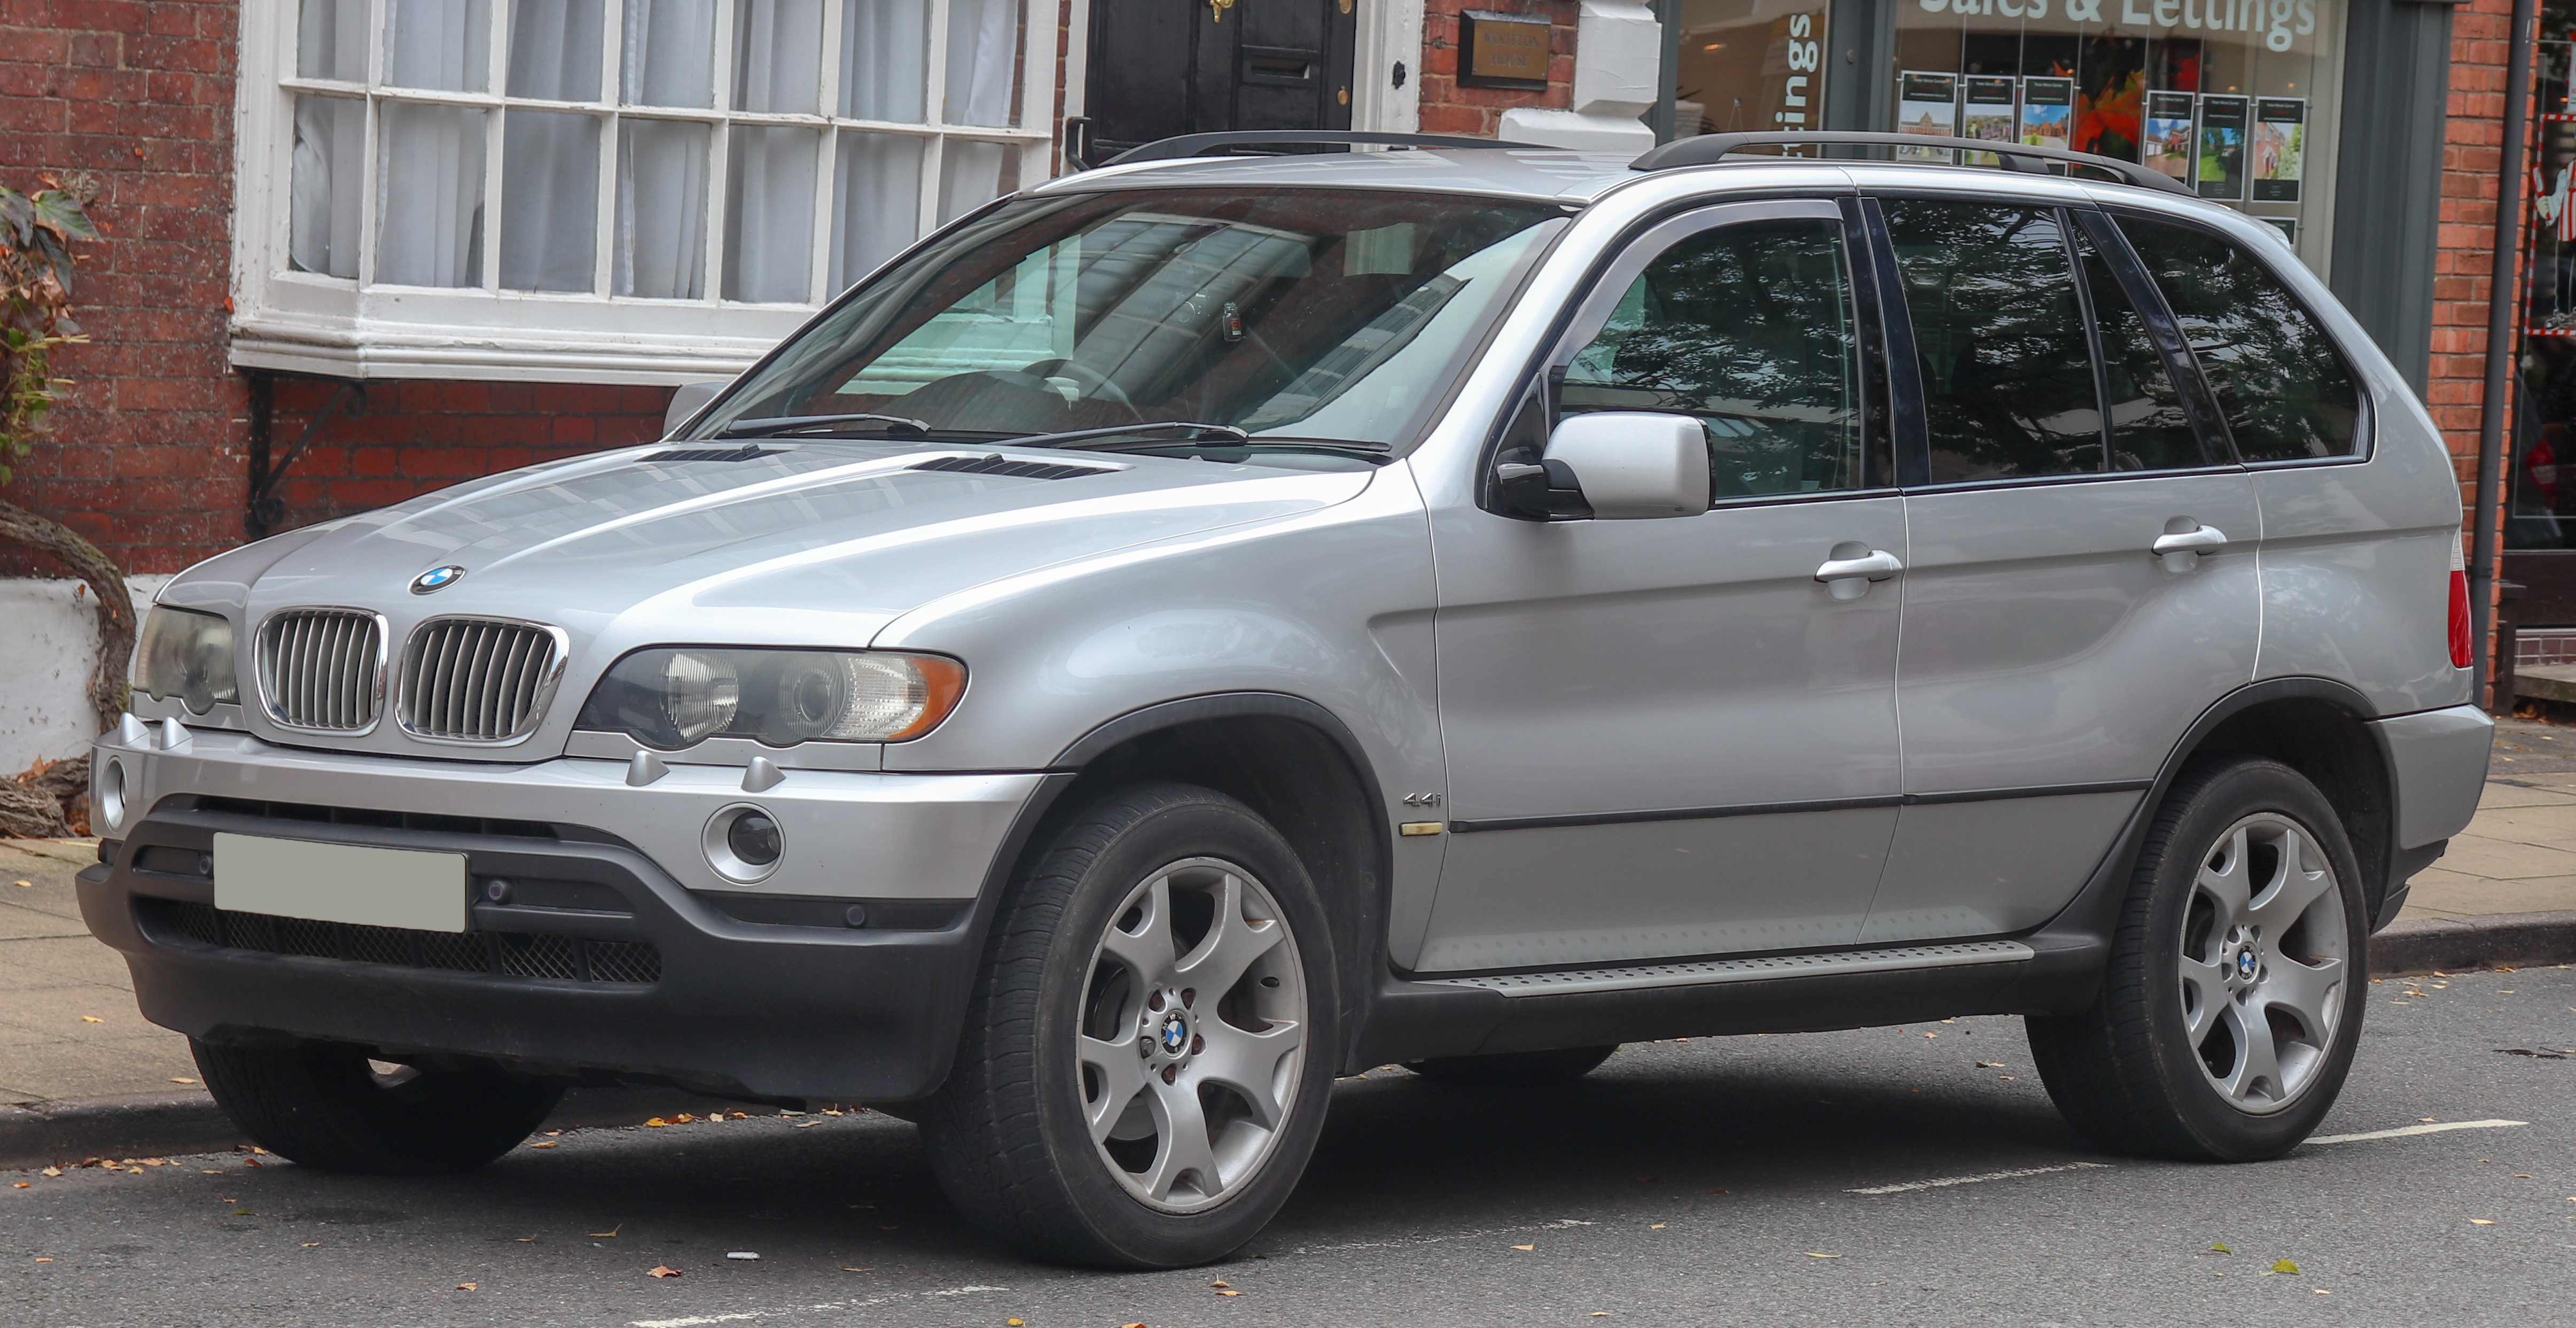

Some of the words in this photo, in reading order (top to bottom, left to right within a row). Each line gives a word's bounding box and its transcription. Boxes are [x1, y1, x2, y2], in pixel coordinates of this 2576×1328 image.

[1484, 32, 1540, 48] WOOTTON
[1491, 52, 1528, 67] HOUSE
[1775, 14, 1818, 157] ings
